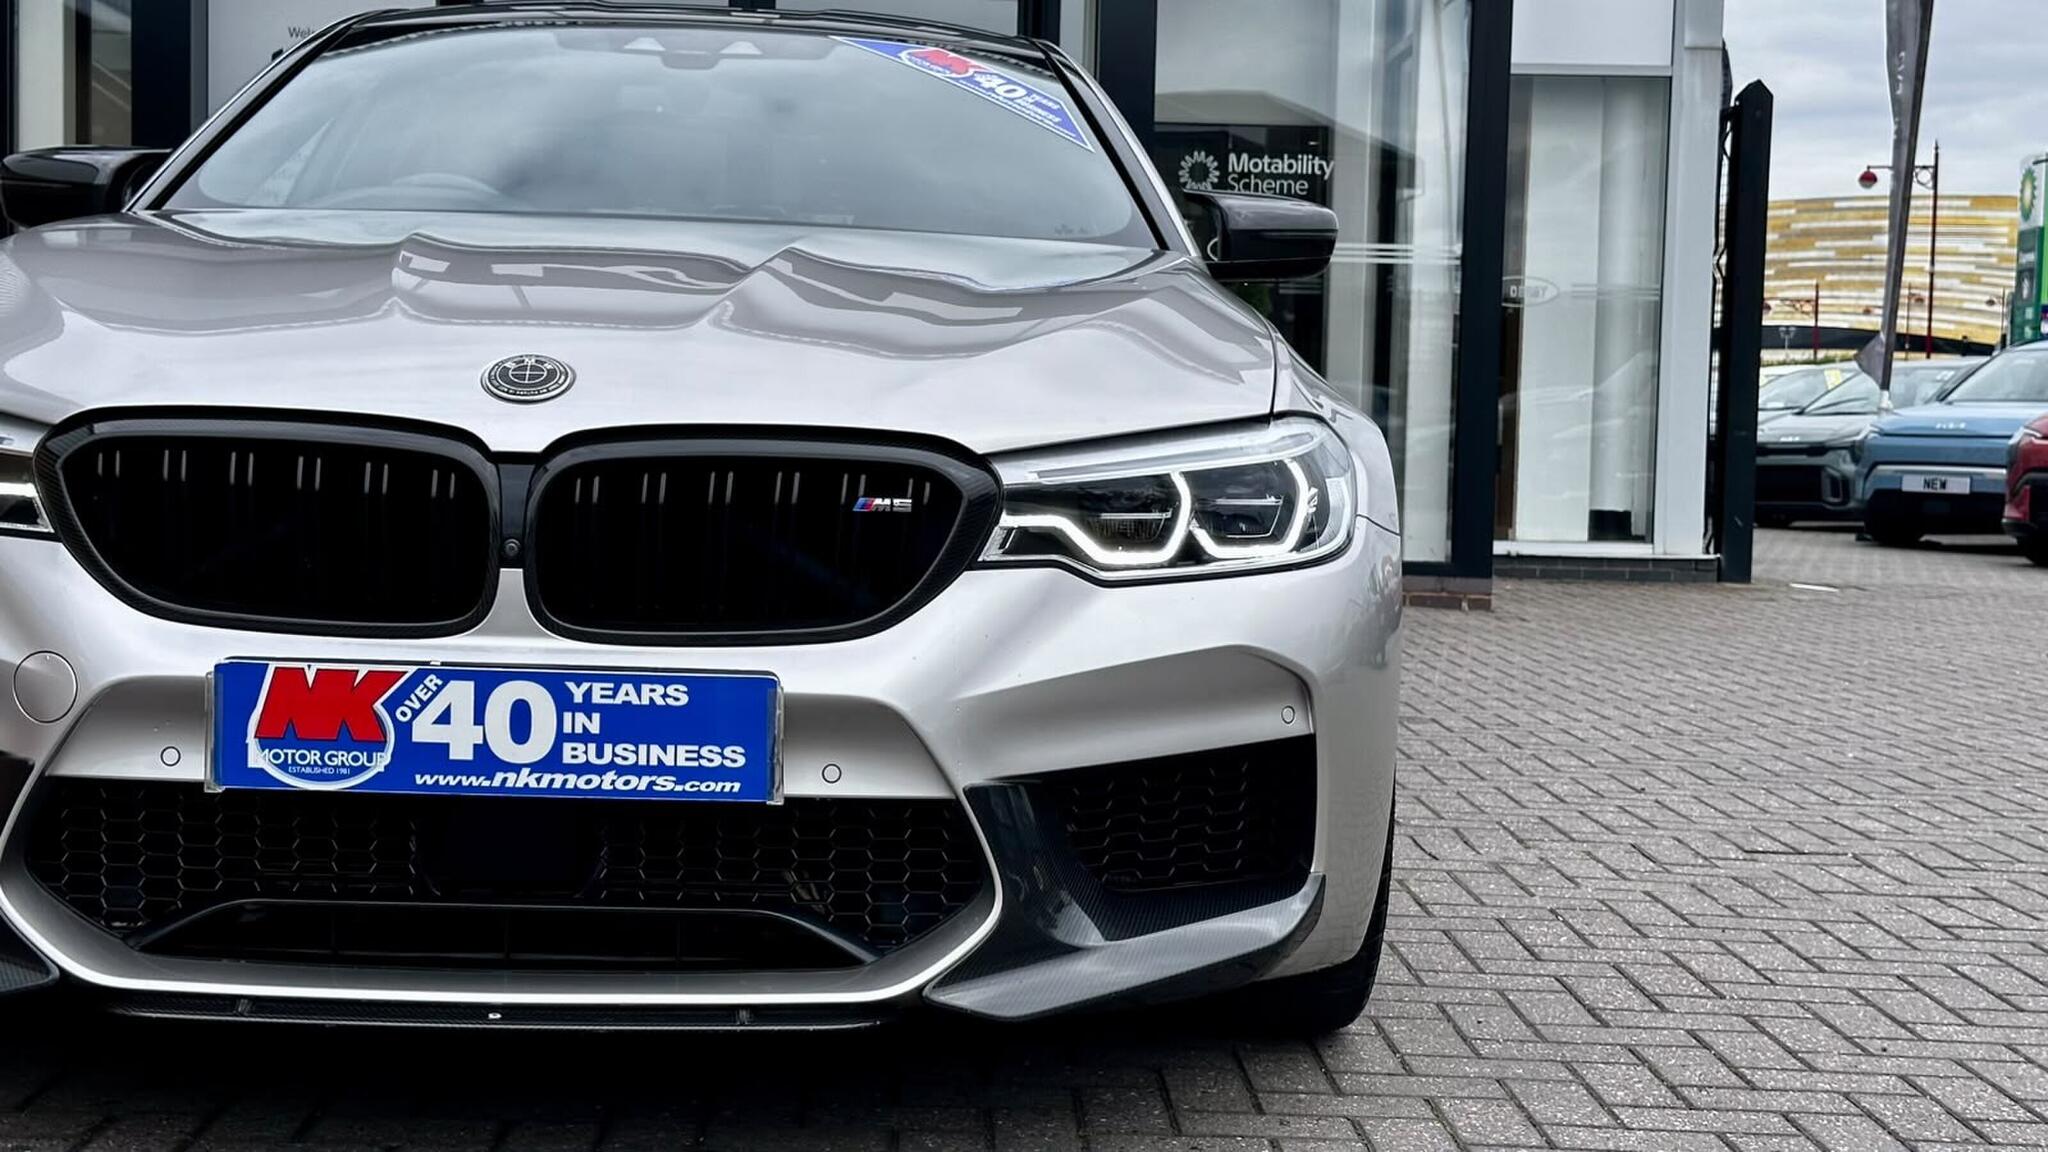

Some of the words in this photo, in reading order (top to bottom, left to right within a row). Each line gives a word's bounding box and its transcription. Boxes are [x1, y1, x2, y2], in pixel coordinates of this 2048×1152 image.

[1228, 152, 1335, 181] Motability
[1228, 174, 1309, 196] Scheme
[1923, 477, 1947, 490] NEW
[254, 666, 409, 743] NK
[395, 673, 444, 722] OVER
[564, 681, 690, 706] YEARS
[412, 679, 557, 764] 40
[562, 712, 600, 734] IN
[257, 748, 321, 766] MOTOR
[324, 750, 388, 770] GROUP
[562, 743, 747, 768] BUSINESS
[288, 766, 335, 775] ESTABLISHED
[336, 767, 351, 775] 1981
[414, 767, 742, 794] www.nkmotors.com
